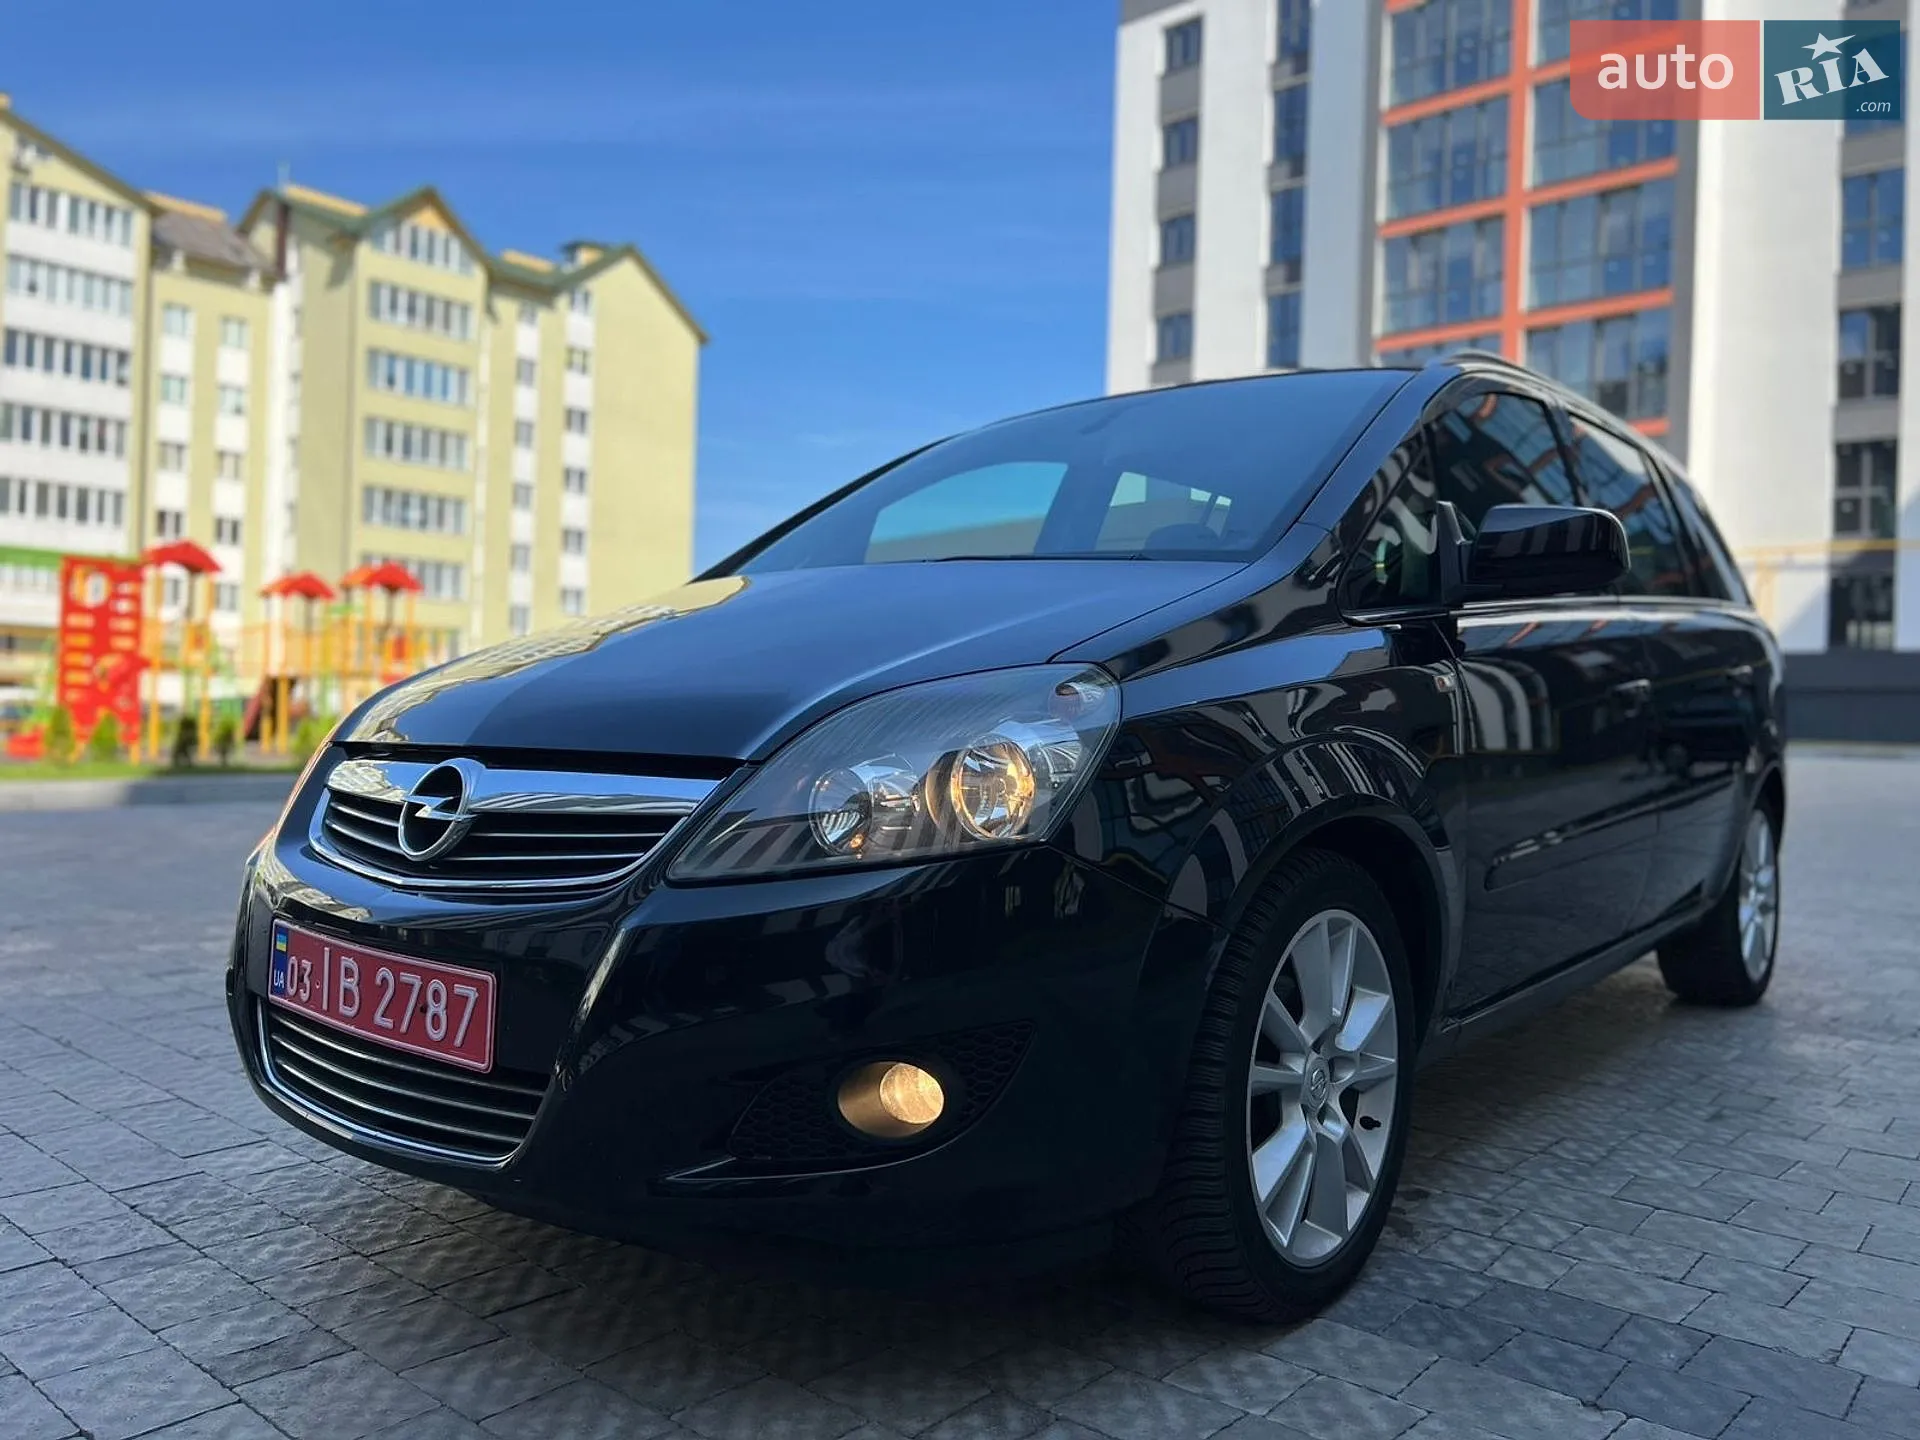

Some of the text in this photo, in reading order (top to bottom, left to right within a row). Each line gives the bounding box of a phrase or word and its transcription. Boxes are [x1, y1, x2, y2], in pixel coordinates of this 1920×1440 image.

[273, 969, 285, 989] UA
[287, 956, 313, 1003] 03
[373, 967, 480, 1048] 2787
